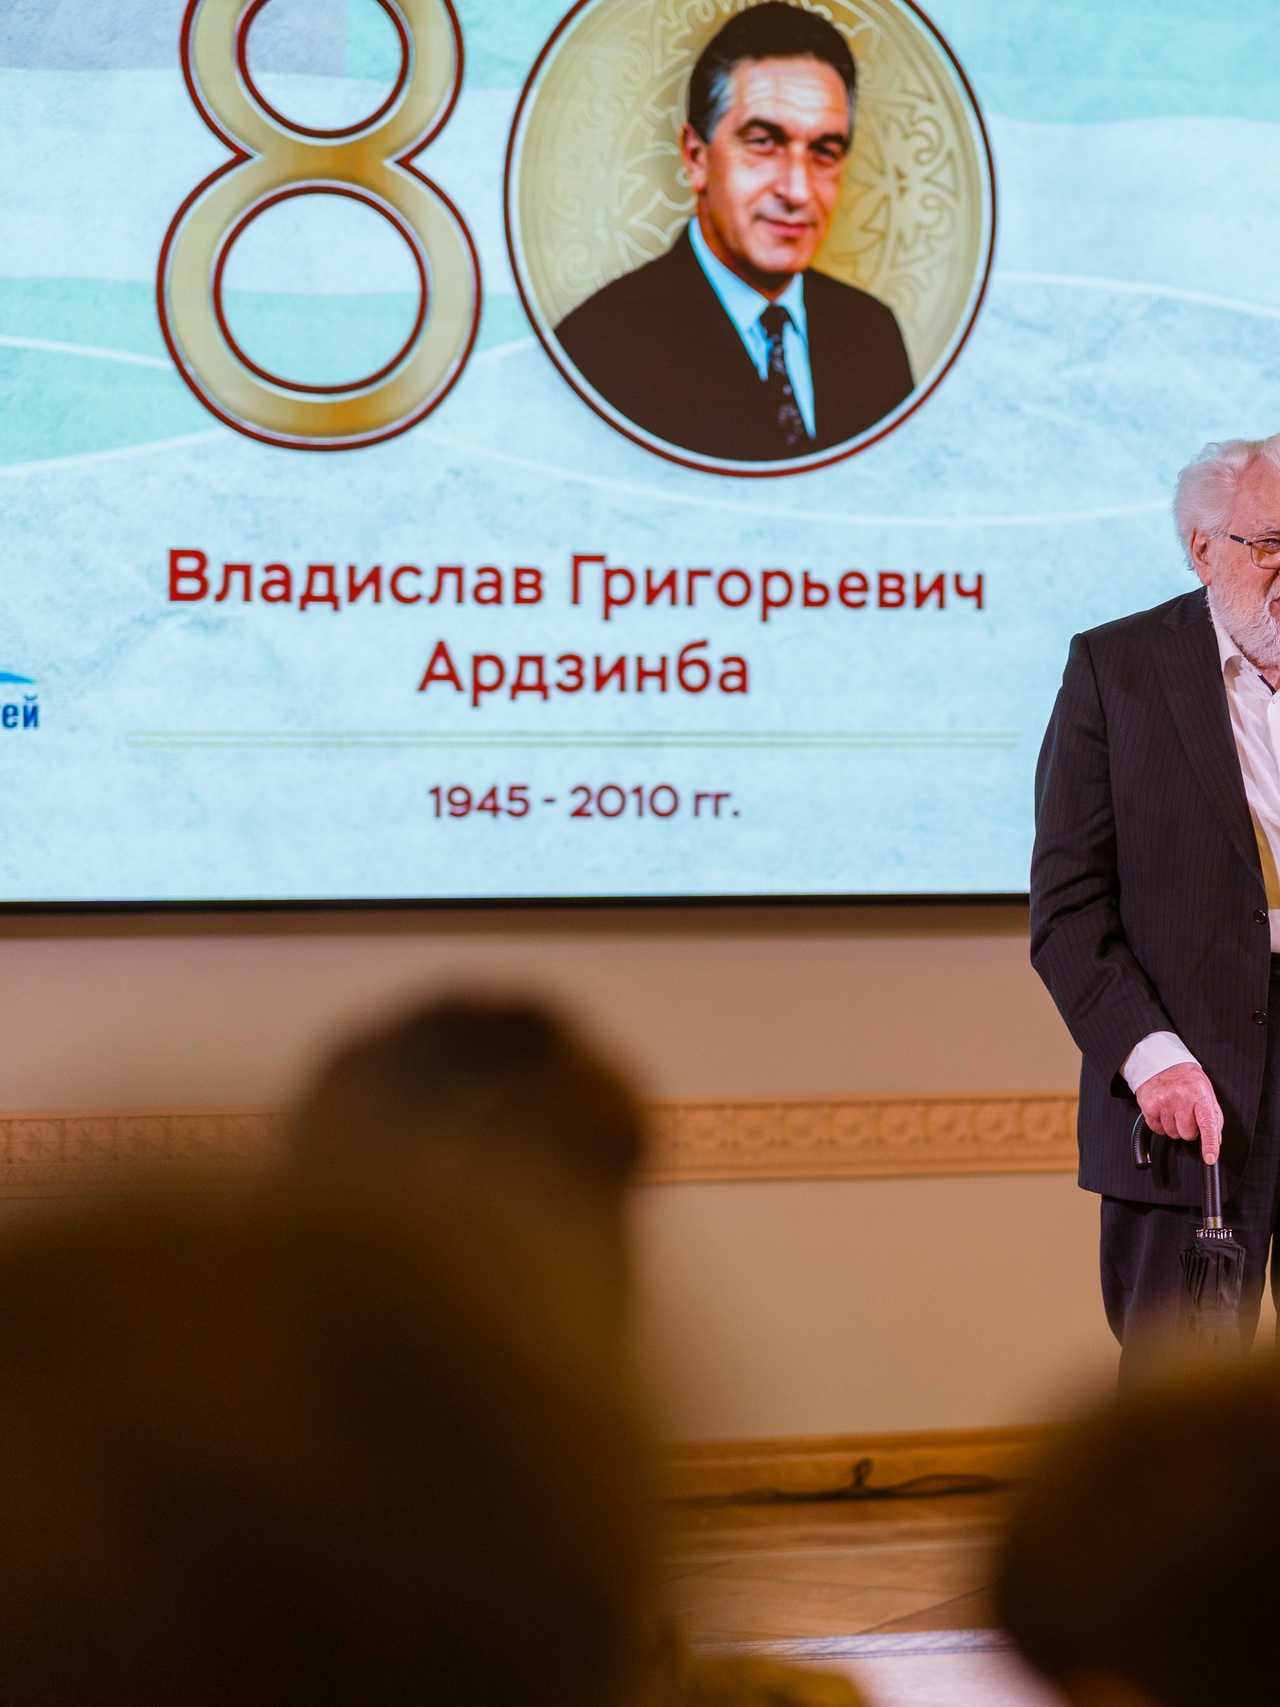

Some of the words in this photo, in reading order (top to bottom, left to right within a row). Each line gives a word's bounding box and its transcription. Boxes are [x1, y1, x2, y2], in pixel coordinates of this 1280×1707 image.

[167, 548, 544, 613] Владислав
[570, 553, 985, 624] Григорьевич
[416, 638, 750, 709] Ардзинба
[428, 784, 531, 818] 1945
[569, 783, 680, 818] 2010
[693, 790, 741, 818] гг.
